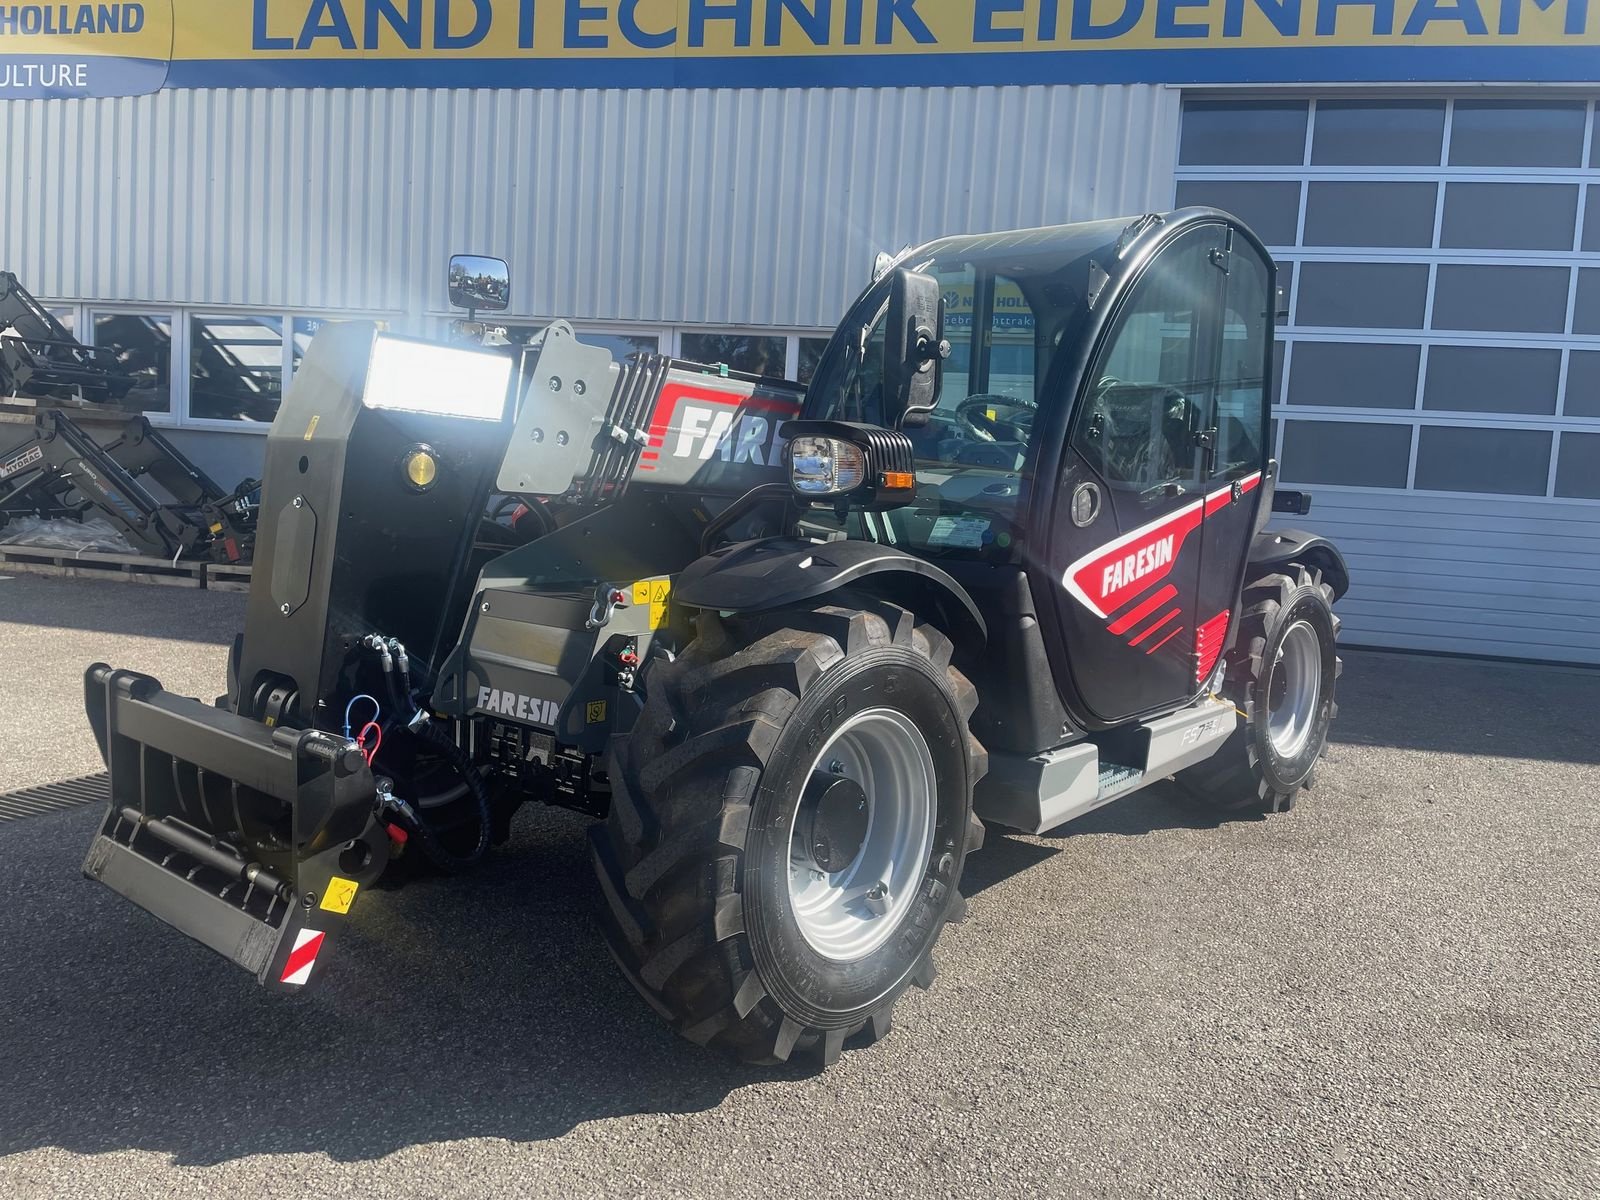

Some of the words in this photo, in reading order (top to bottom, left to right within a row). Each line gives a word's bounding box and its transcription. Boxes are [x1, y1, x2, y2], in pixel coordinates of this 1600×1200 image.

[0, 3, 145, 35] HOLLAND
[5, 451, 42, 474] HYDRAC
[1101, 533, 1174, 599] FARESIN
